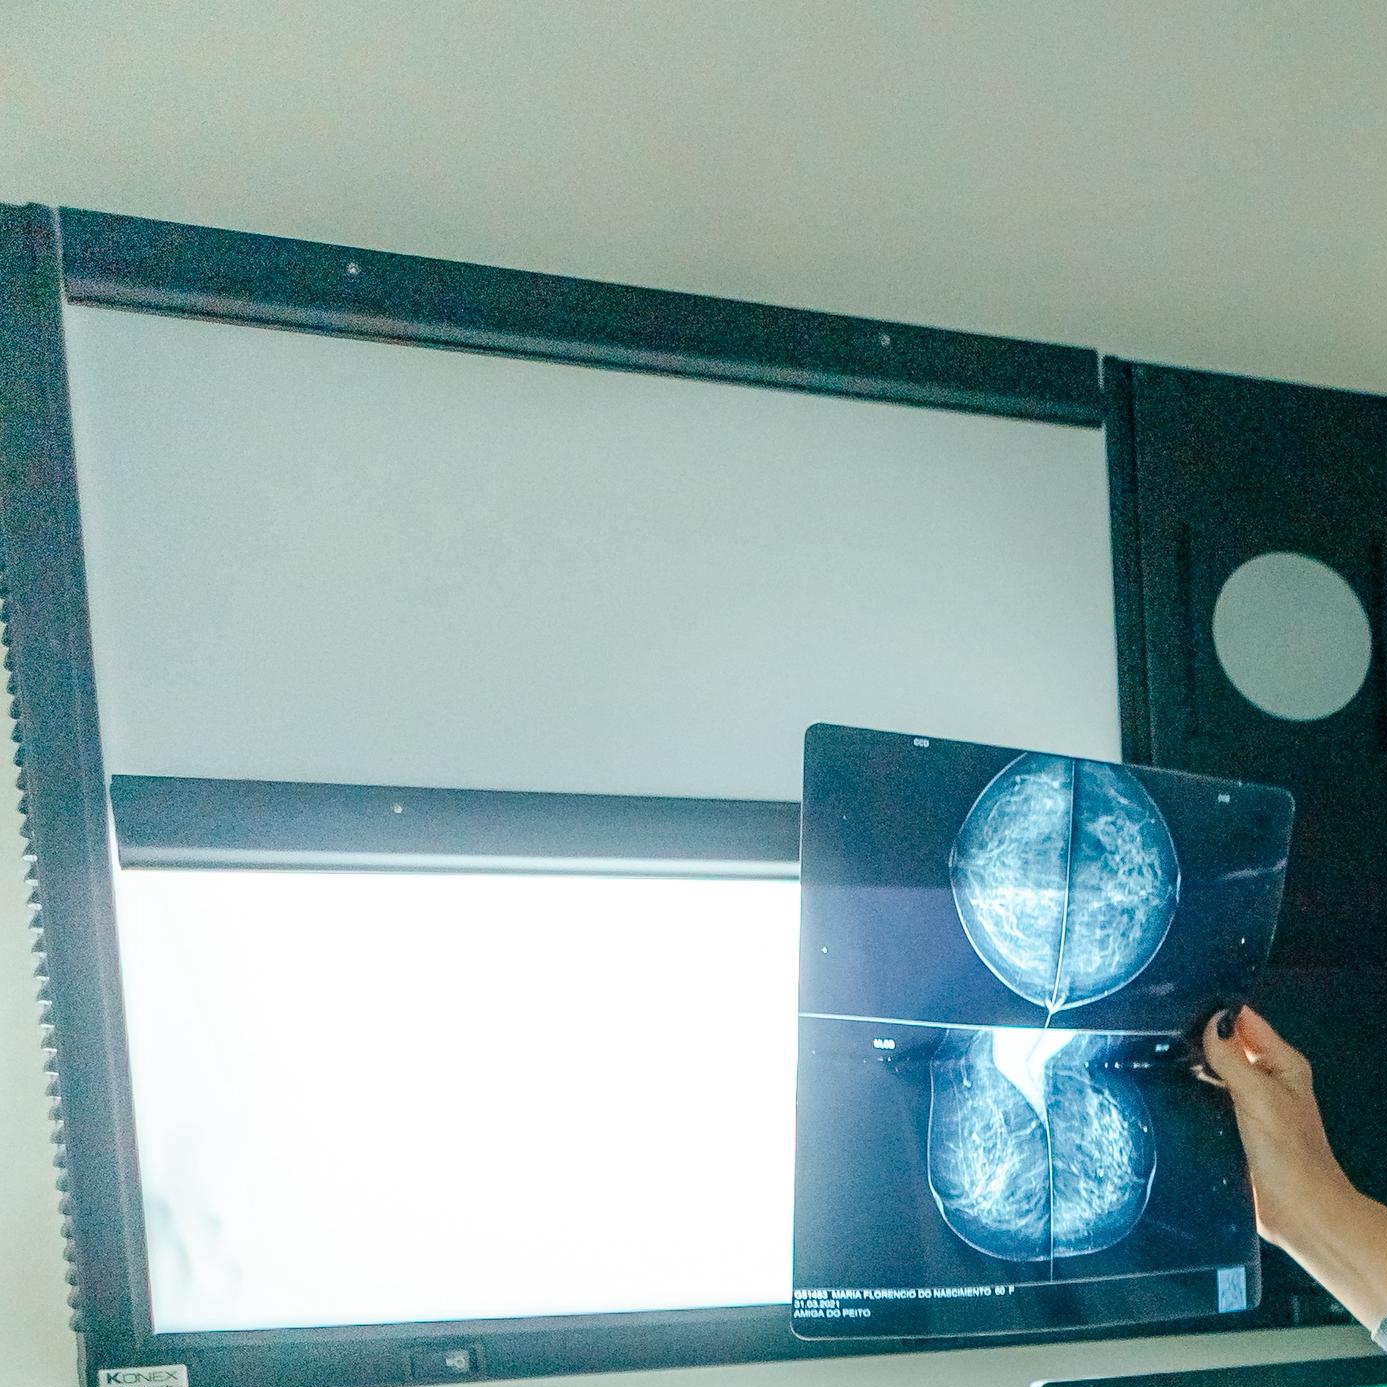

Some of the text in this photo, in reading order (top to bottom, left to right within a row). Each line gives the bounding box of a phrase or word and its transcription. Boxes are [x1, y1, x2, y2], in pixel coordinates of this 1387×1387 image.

[832, 1288, 862, 1299] MARIA
[863, 1288, 916, 1299] FLORENCIO
[918, 1288, 932, 1298] DO
[934, 1286, 991, 1298] NASCIMENTO
[794, 1308, 871, 1318] AMIGA DO PEITO
[106, 1370, 178, 1385] KONEX
